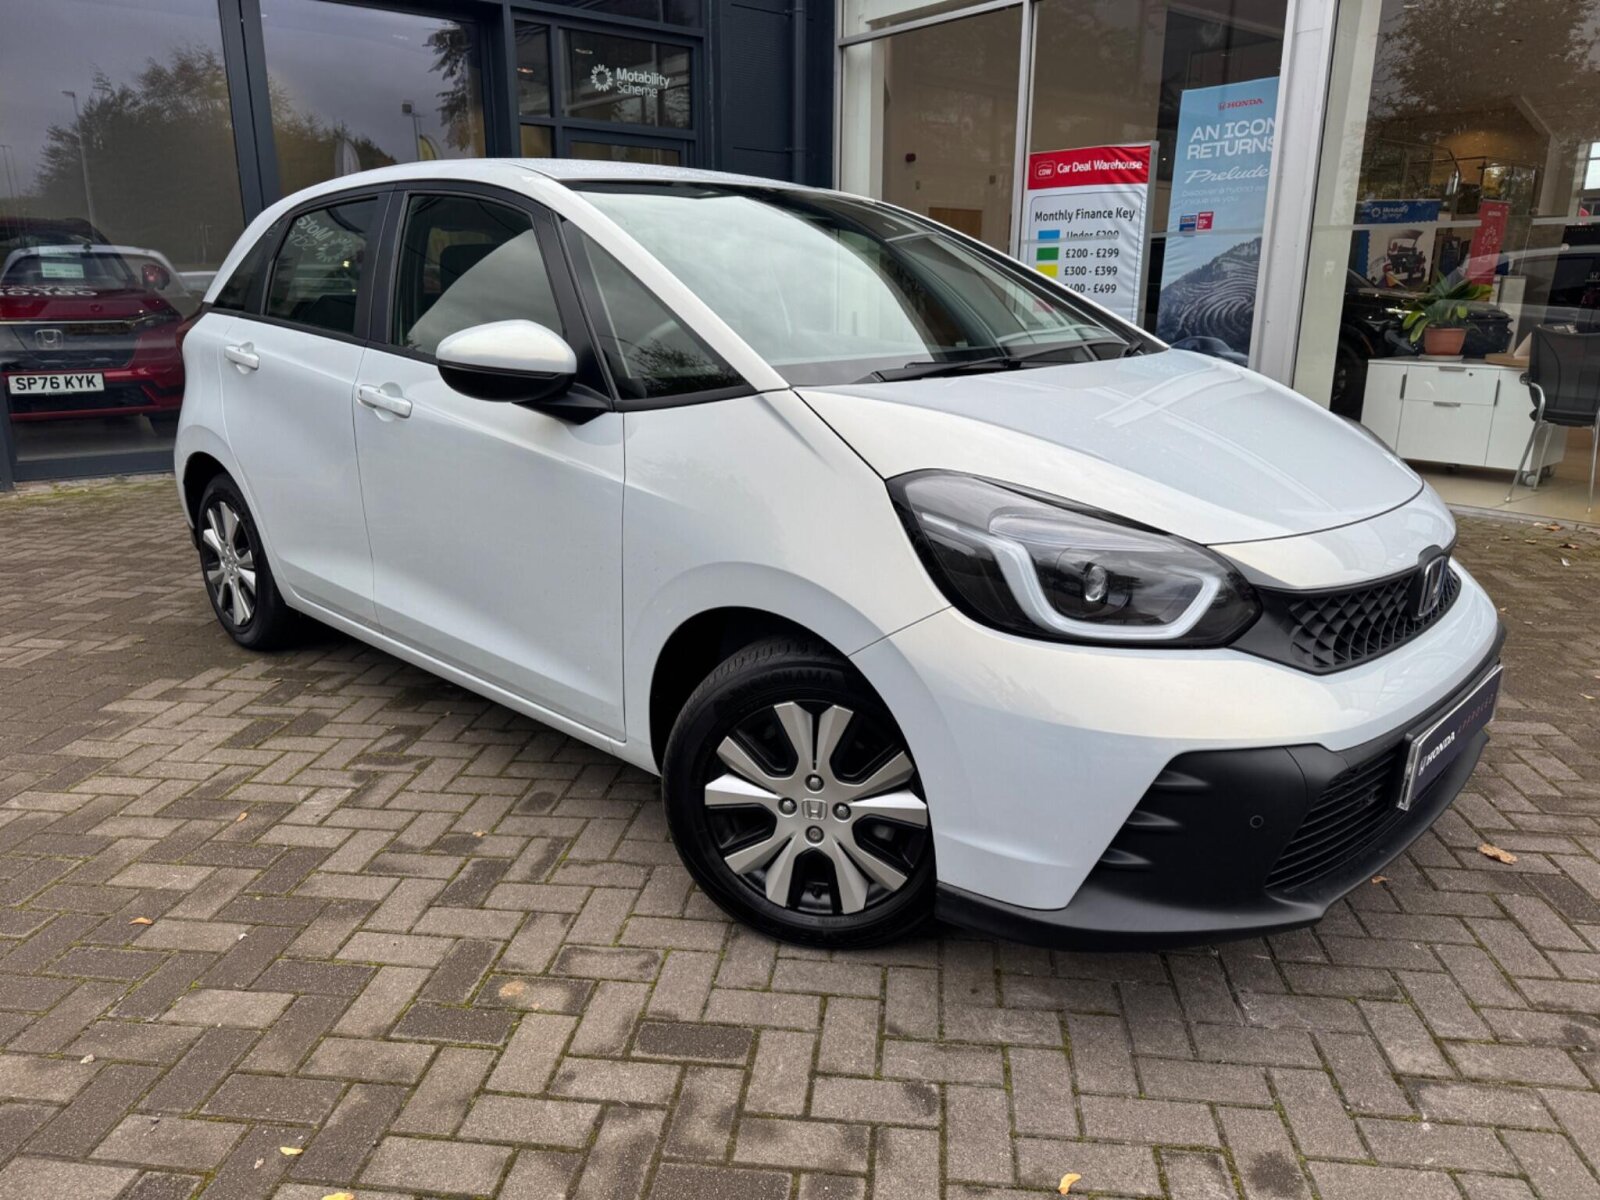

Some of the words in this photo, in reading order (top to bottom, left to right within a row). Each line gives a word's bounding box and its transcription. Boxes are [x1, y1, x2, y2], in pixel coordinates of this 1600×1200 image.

[616, 67, 670, 89] Motability
[616, 81, 658, 97] Scheme
[1190, 124, 1220, 143] AN
[1057, 163, 1072, 174] Car
[1072, 160, 1092, 173] Deal
[1093, 159, 1143, 171] Warehouse
[1184, 164, 1269, 184] Prelude
[1034, 208, 1074, 223] Monthly
[1075, 208, 1113, 220] Finance
[1115, 207, 1135, 221] Key
[1066, 230, 1093, 240] Under
[1065, 248, 1088, 258] £200
[1096, 248, 1119, 258] £299
[1064, 266, 1087, 276] £300
[1095, 266, 1118, 276] £399
[1093, 284, 1117, 294] £499
[15, 375, 60, 391] SP76
[64, 375, 97, 389] KYK
[1425, 731, 1455, 767] HONDA
